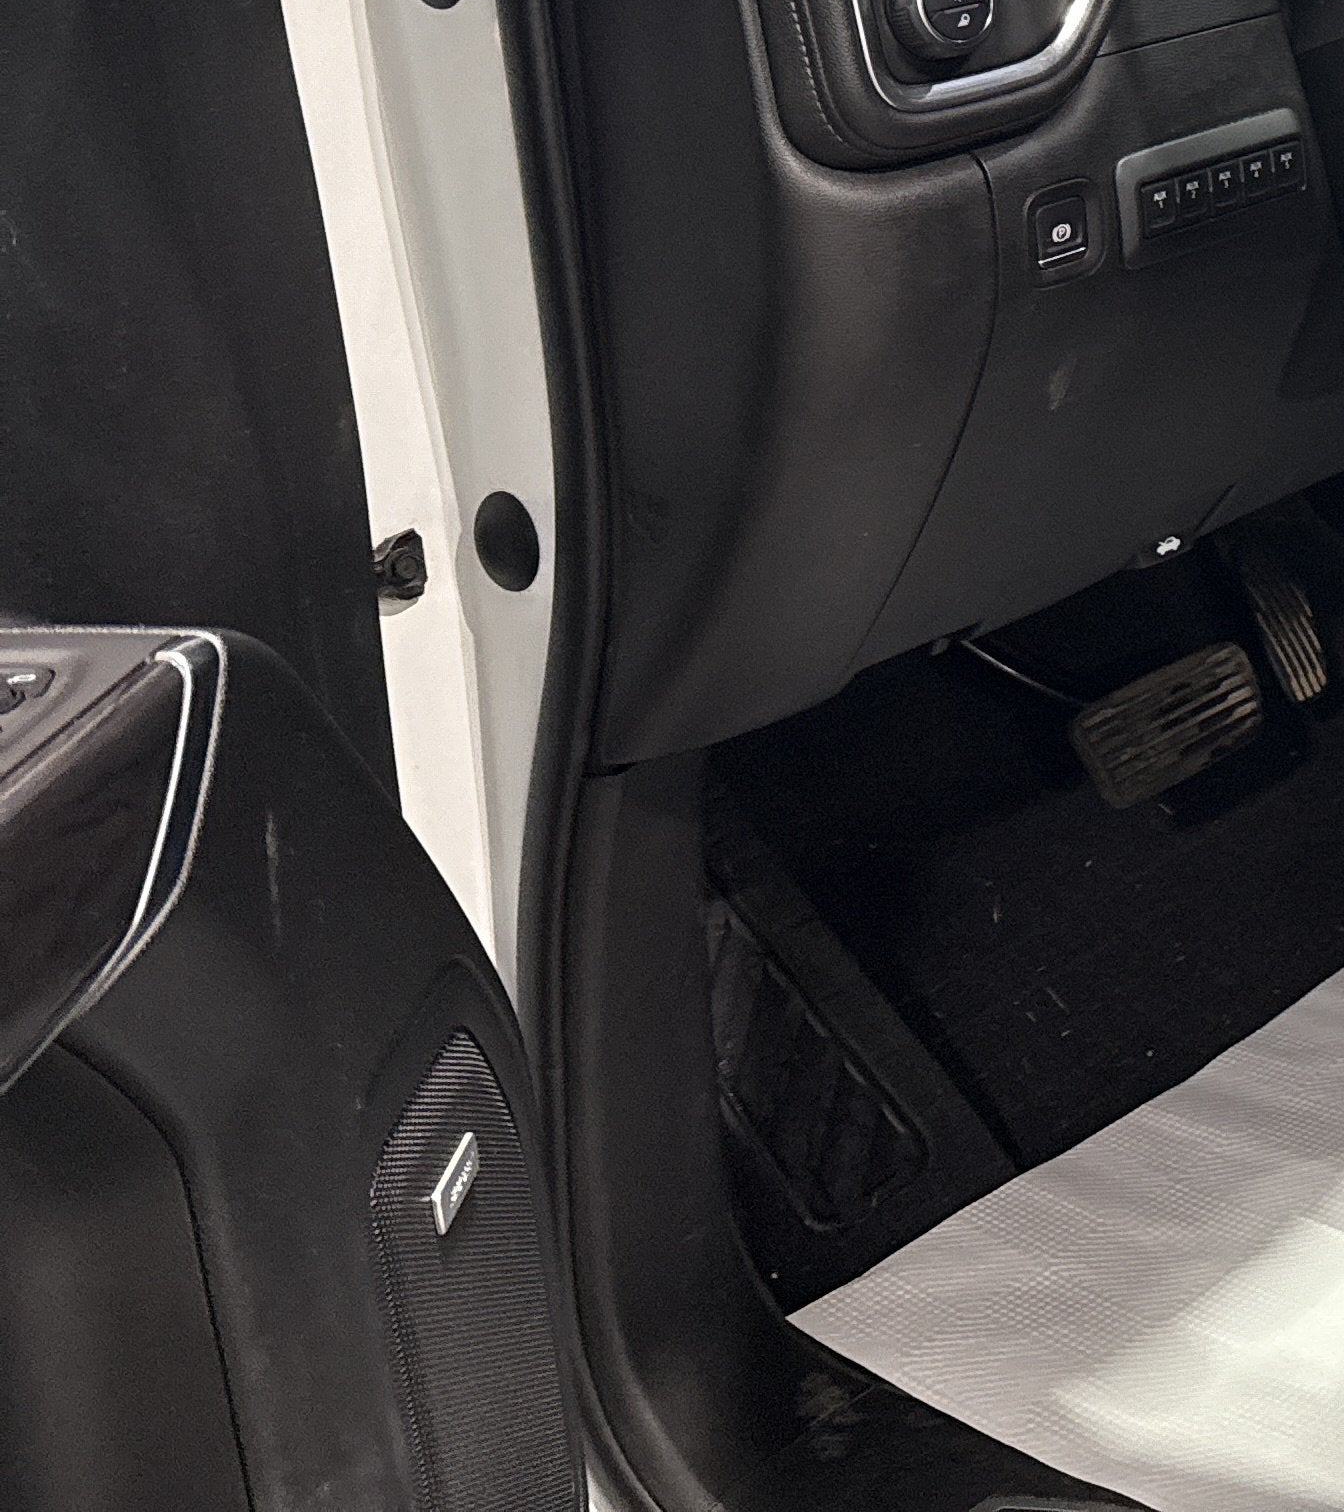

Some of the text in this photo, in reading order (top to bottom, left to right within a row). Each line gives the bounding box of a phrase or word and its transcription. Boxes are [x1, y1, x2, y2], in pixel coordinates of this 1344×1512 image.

[1280, 152, 1293, 162] AUX
[1250, 161, 1263, 171] AUX
[1218, 171, 1231, 181] AUX
[1186, 181, 1199, 191] AUX
[1153, 191, 1167, 202] AUX
